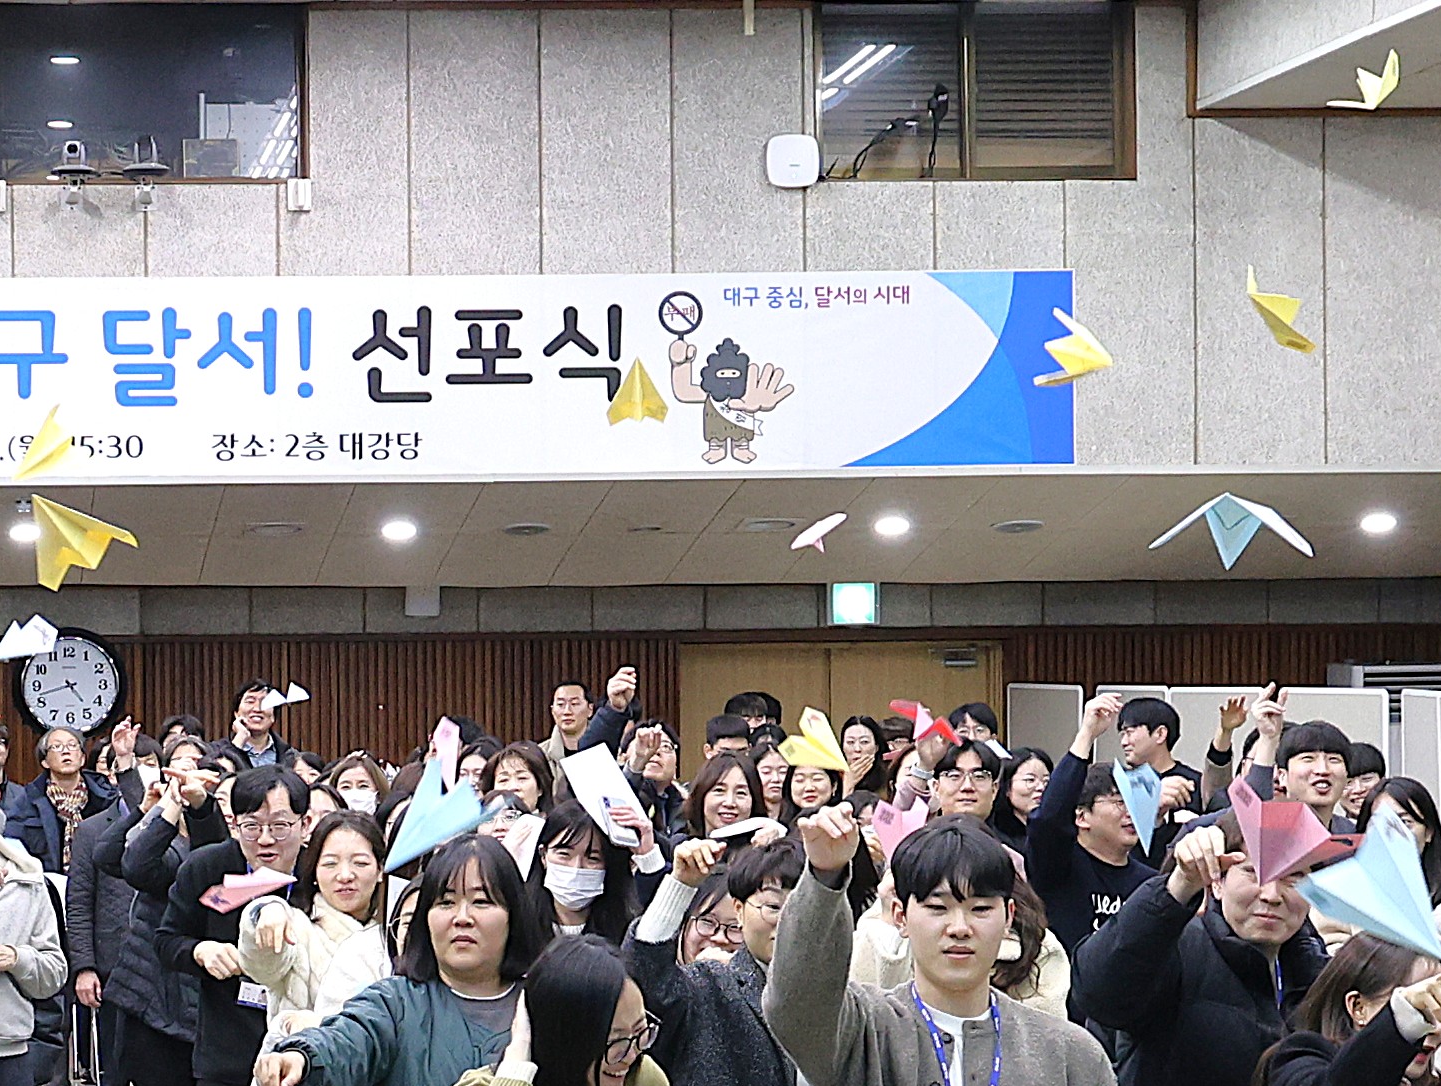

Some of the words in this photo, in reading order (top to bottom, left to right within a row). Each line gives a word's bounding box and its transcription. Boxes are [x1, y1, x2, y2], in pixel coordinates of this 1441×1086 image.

[723, 287, 760, 307] 대구
[766, 286, 809, 310] 중심,
[814, 286, 867, 308] 달서의
[874, 286, 910, 304] 시대
[102, 307, 314, 407] 달서!
[352, 304, 623, 403] 선포식
[213, 433, 276, 462] 장소:
[285, 431, 328, 461] 2층
[339, 432, 423, 460] 대강당
[48, 651, 58, 662] 11
[62, 646, 76, 658] 12
[83, 650, 89, 661] 1
[35, 664, 47, 675] 10
[94, 662, 104, 674] 2
[32, 680, 42, 692] 9
[98, 679, 108, 690] 3
[37, 697, 47, 708] 8
[93, 694, 103, 707] 4
[49, 709, 59, 721] 7
[66, 712, 76, 724] 6
[82, 708, 92, 720] 5
